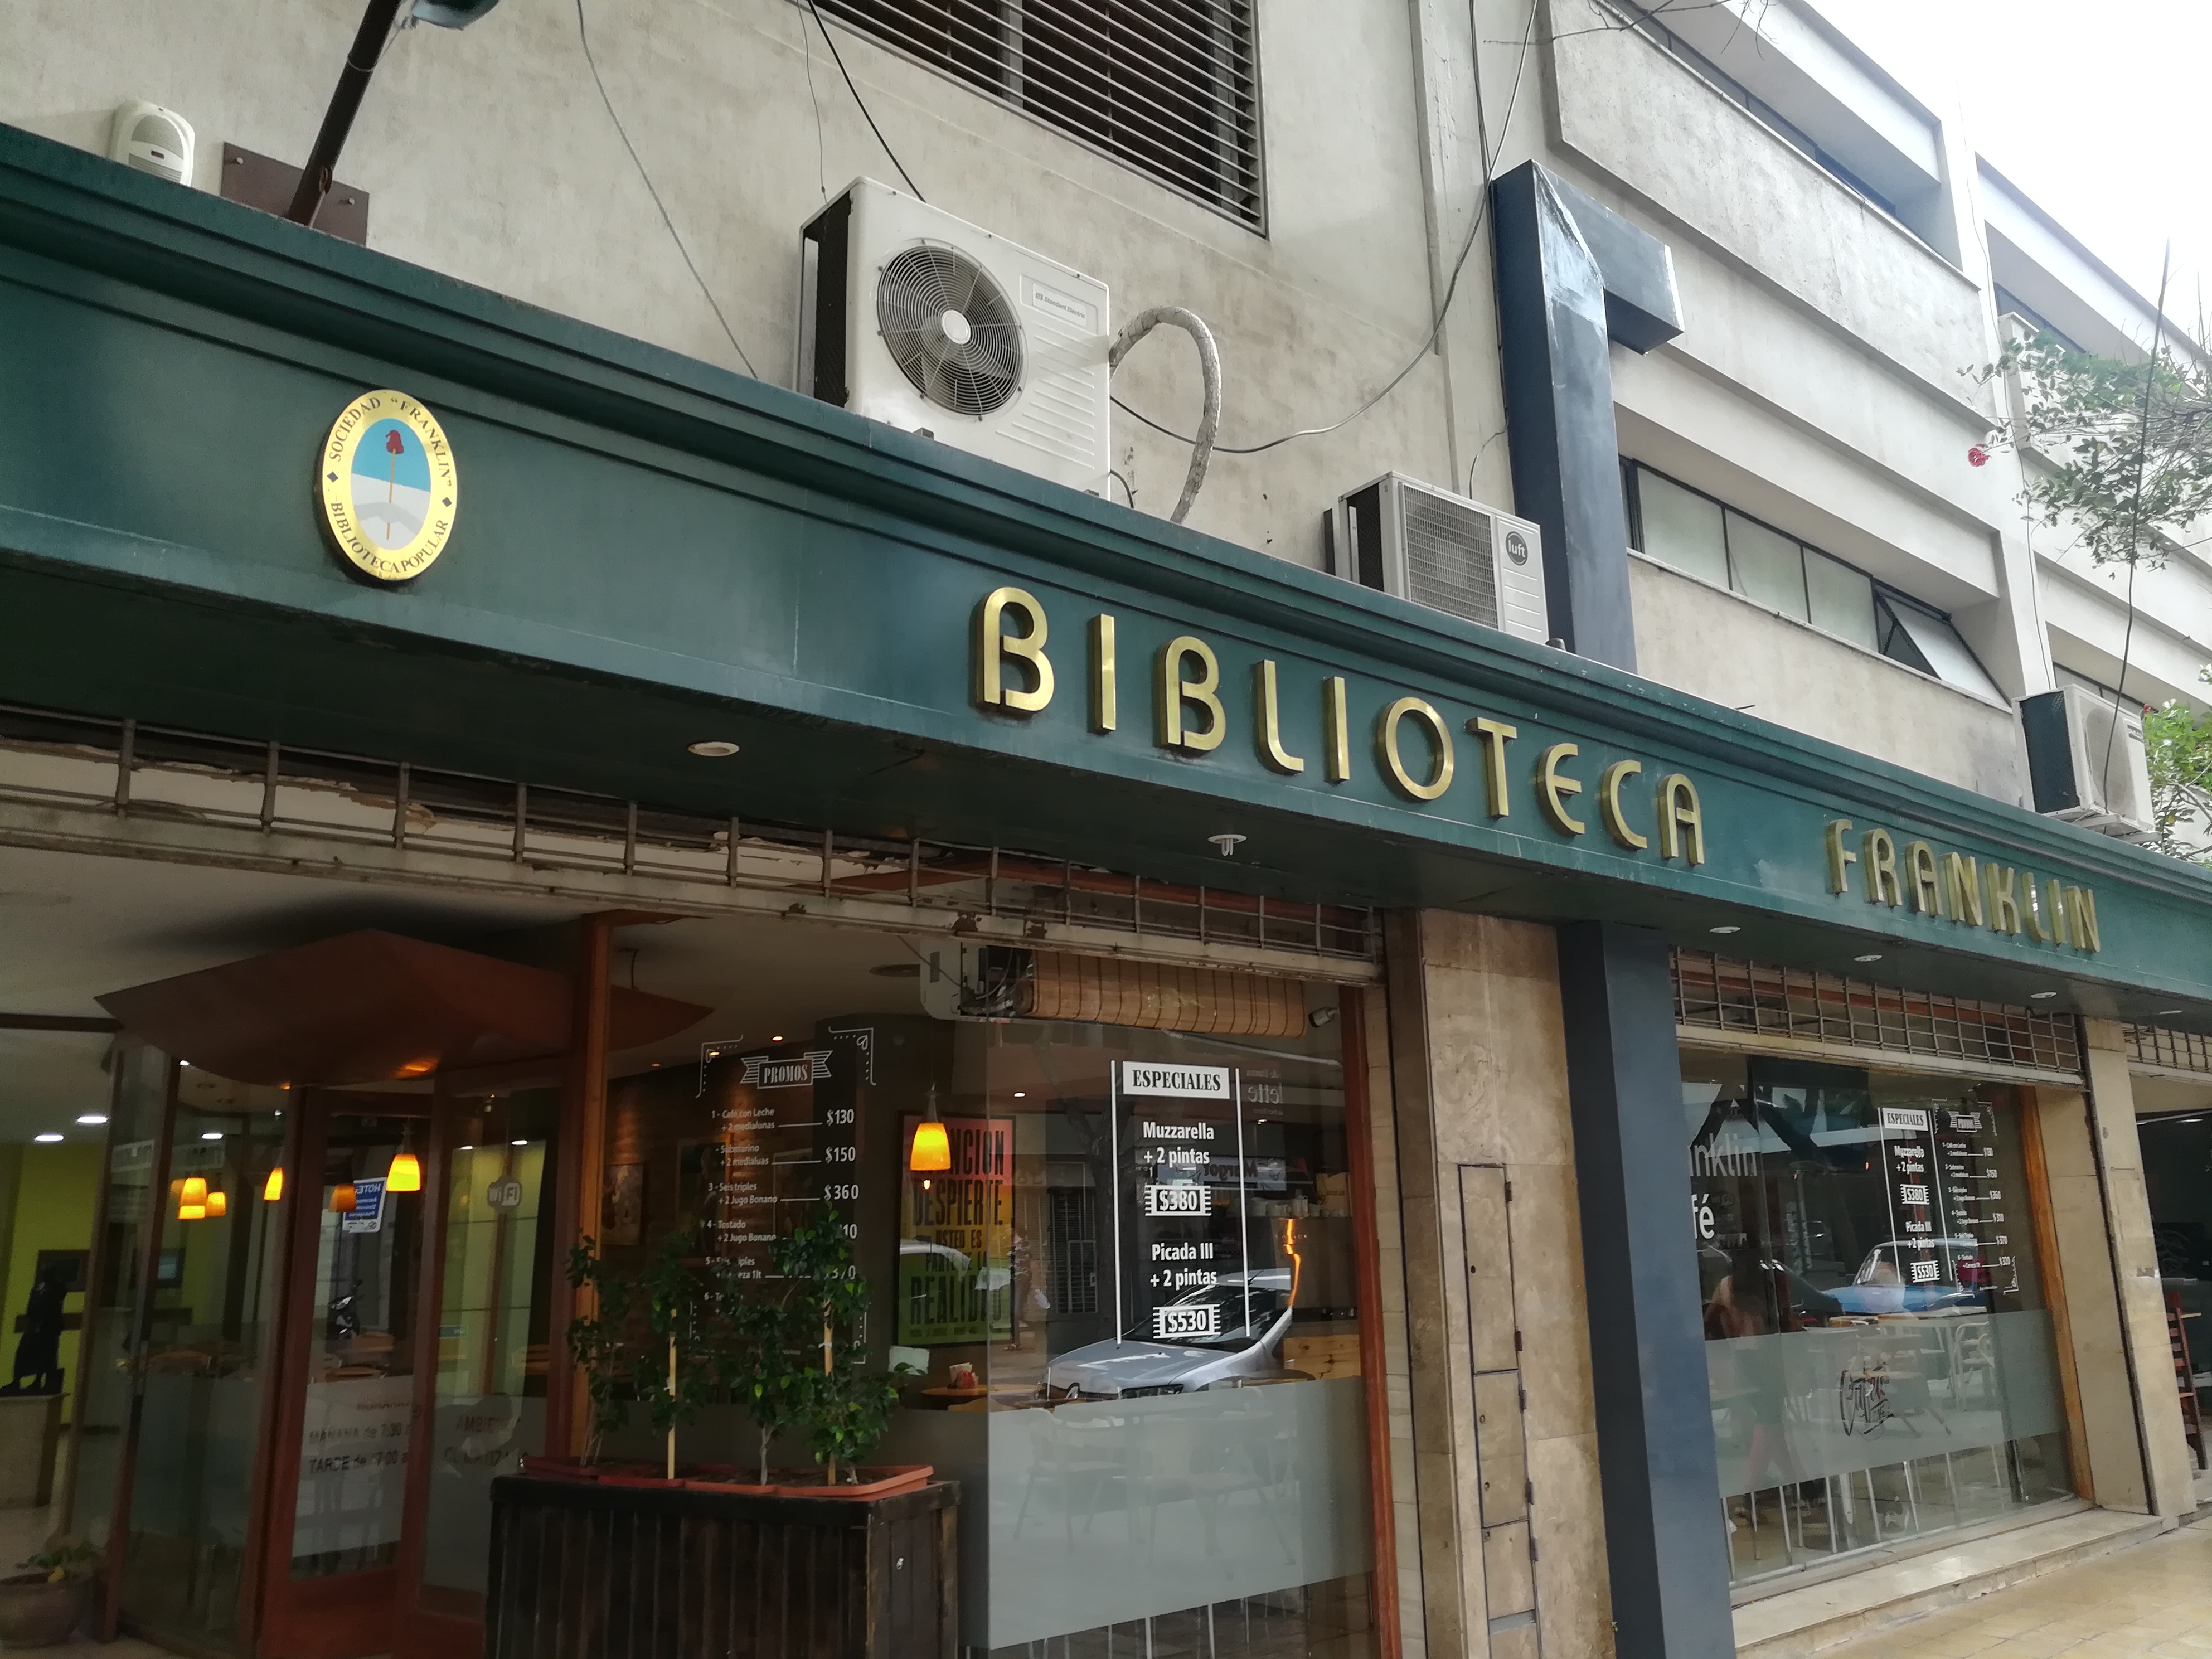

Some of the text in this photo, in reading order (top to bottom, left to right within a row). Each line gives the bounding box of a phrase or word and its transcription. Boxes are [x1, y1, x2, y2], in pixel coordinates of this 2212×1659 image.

[1044, 296, 1086, 319] Standard Electric
[328, 396, 381, 462] SOCIEDAD
[1508, 539, 1526, 558] luft
[976, 586, 2101, 953] BIBLIOTECA FRANKLIN
[763, 1064, 808, 1084] PROMOS
[1132, 1069, 1221, 1091] ESPECIALES
[734, 1121, 775, 1131] medialunas
[826, 1108, 855, 1127] $130
[753, 1107, 775, 1117] Leche
[1886, 1112, 1924, 1126] ESPECIALES
[1143, 1121, 1215, 1140] Muzzarella
[825, 1146, 856, 1165] $150
[943, 1128, 1004, 1175] NCION
[1156, 1146, 1165, 1163] 2
[1168, 1146, 1210, 1168] pintas
[1894, 1145, 1925, 1158] Muzzarella
[1901, 1161, 1906, 1172] 2
[1907, 1162, 1925, 1175] pintas
[708, 1183, 714, 1192] 3
[719, 1182, 734, 1191] Seis
[734, 1182, 758, 1194] triples
[730, 1196, 748, 1206] Jugo
[749, 1195, 778, 1204] Bonano
[824, 1184, 860, 1201] $360
[913, 1178, 1003, 1226] DESPIERTE
[1158, 1189, 1197, 1212] $380
[707, 1220, 712, 1228] 4
[718, 1220, 746, 1229] Tostado
[1905, 1221, 1925, 1233] Picada
[729, 1233, 747, 1244] Jugo
[970, 1229, 982, 1249] ES
[1912, 1237, 1917, 1248] 2
[1917, 1236, 1936, 1251] pintas
[1151, 1242, 1214, 1261] Picada III
[1163, 1269, 1172, 1287] 2
[1175, 1267, 1217, 1291] pintas
[1167, 1310, 1207, 1333] $530
